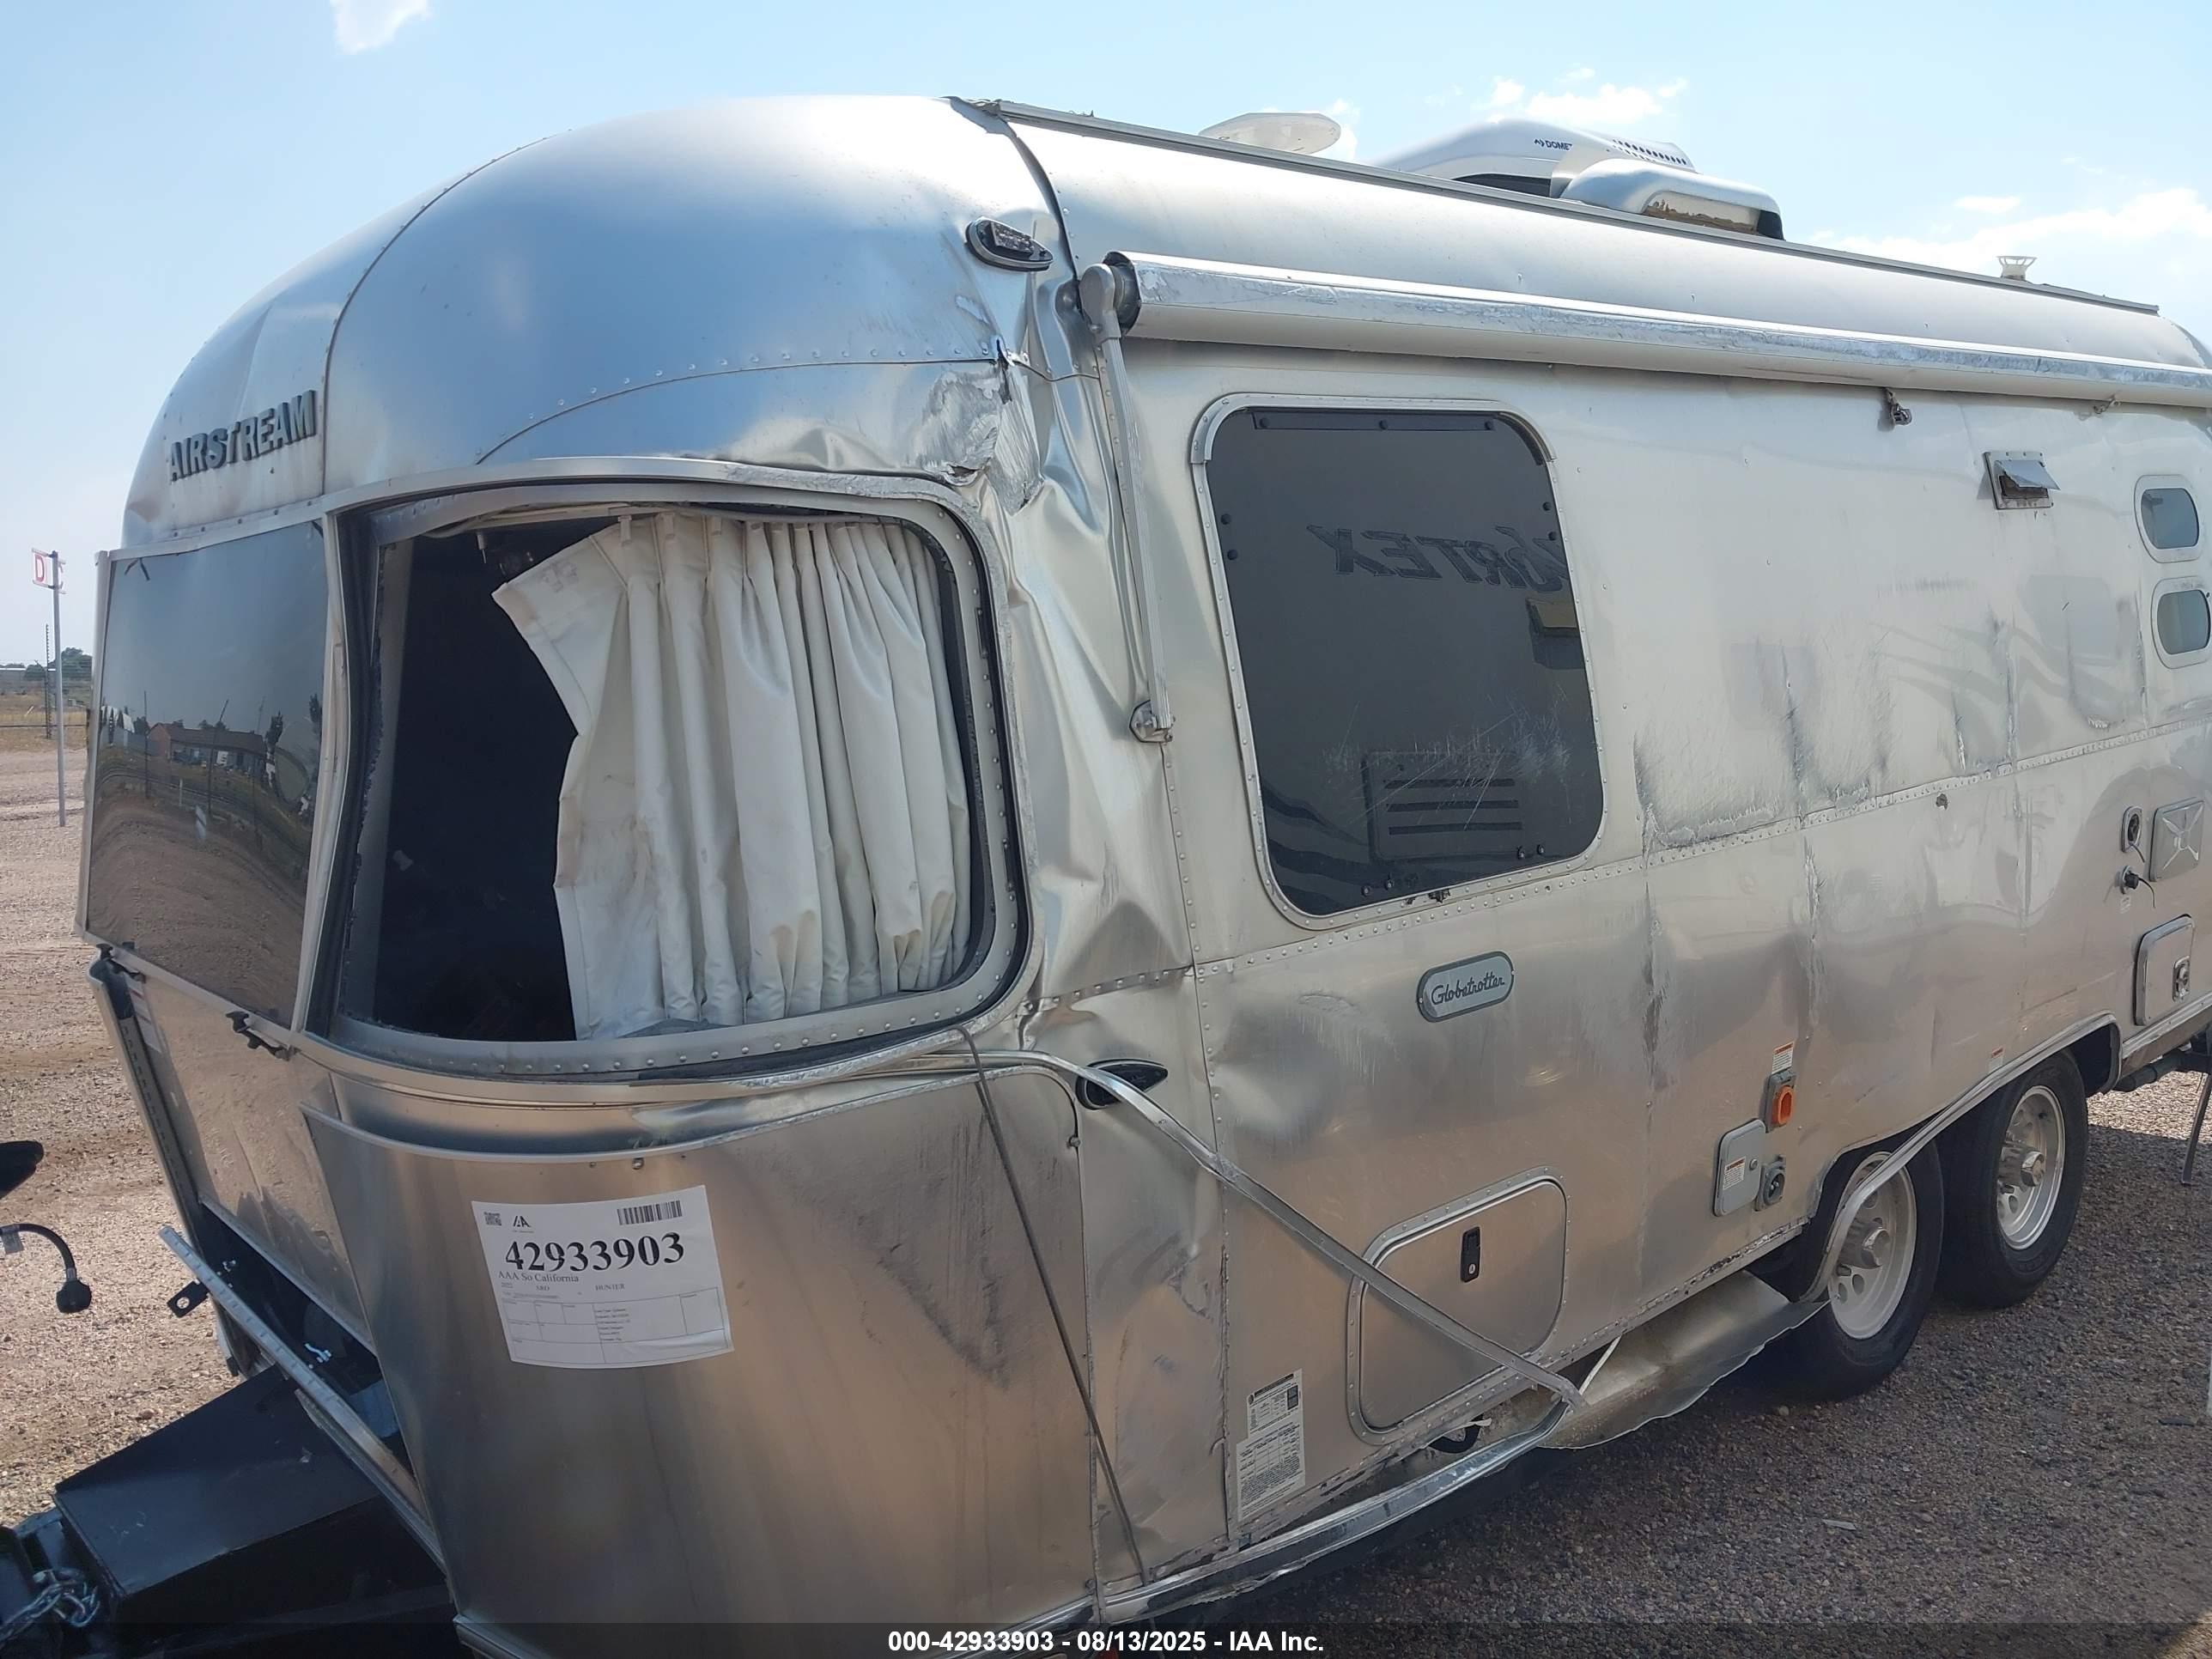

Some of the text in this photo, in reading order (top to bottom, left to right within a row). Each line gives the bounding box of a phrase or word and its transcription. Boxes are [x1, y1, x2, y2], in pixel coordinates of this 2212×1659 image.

[168, 390, 316, 482] AIRSTREAM
[1431, 971, 1504, 1005] Globetrotter
[505, 1231, 684, 1273] 42933903
[498, 1271, 579, 1283] AAA So California
